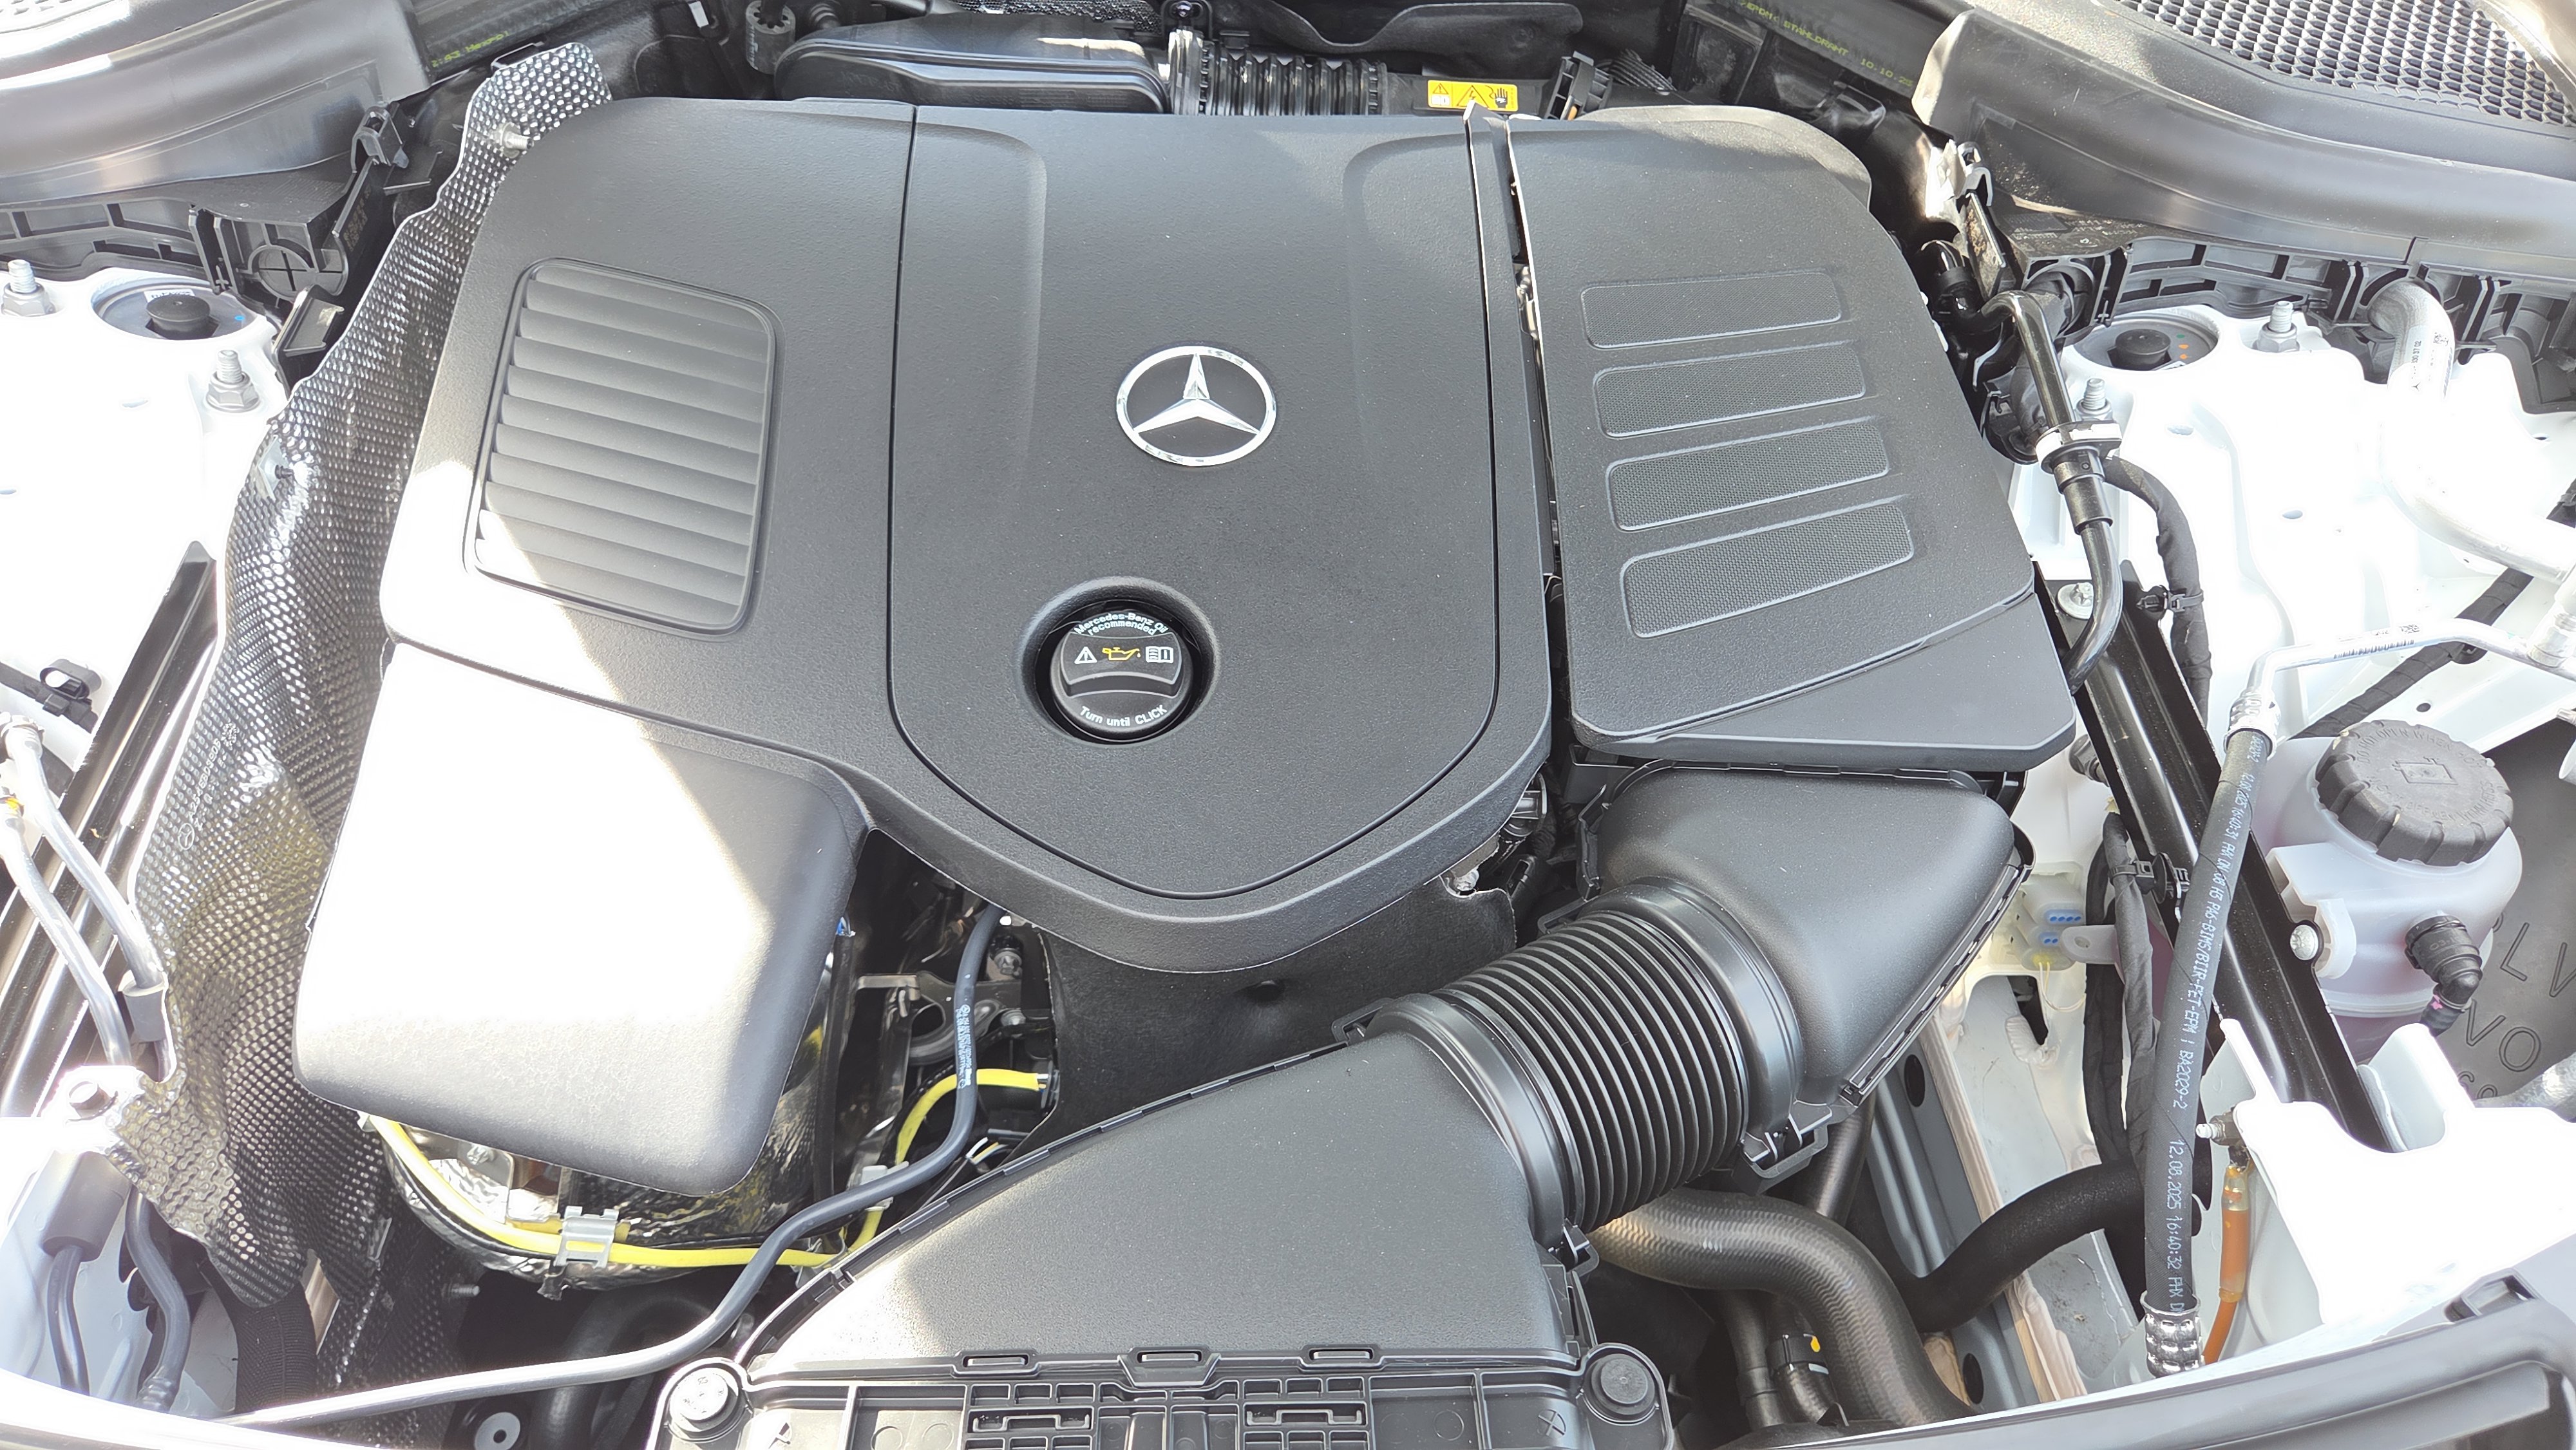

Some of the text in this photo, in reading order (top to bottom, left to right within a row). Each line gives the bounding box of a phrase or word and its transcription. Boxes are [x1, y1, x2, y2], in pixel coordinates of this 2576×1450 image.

[1783, 20, 1849, 57] STAHLDRAHT
[1074, 612, 1169, 634] Mercedes-Benz Oil
[1088, 620, 1156, 636] recommended
[1080, 704, 1167, 726] Turn until CLICK
[2234, 772, 2255, 808] 12.08.2025
[2224, 807, 2245, 840] 16:40:31
[2172, 1050, 2193, 1109] BA2029-2
[2166, 1140, 2184, 1210] 12.08.2025
[2166, 1215, 2183, 1270] 16:40:32
